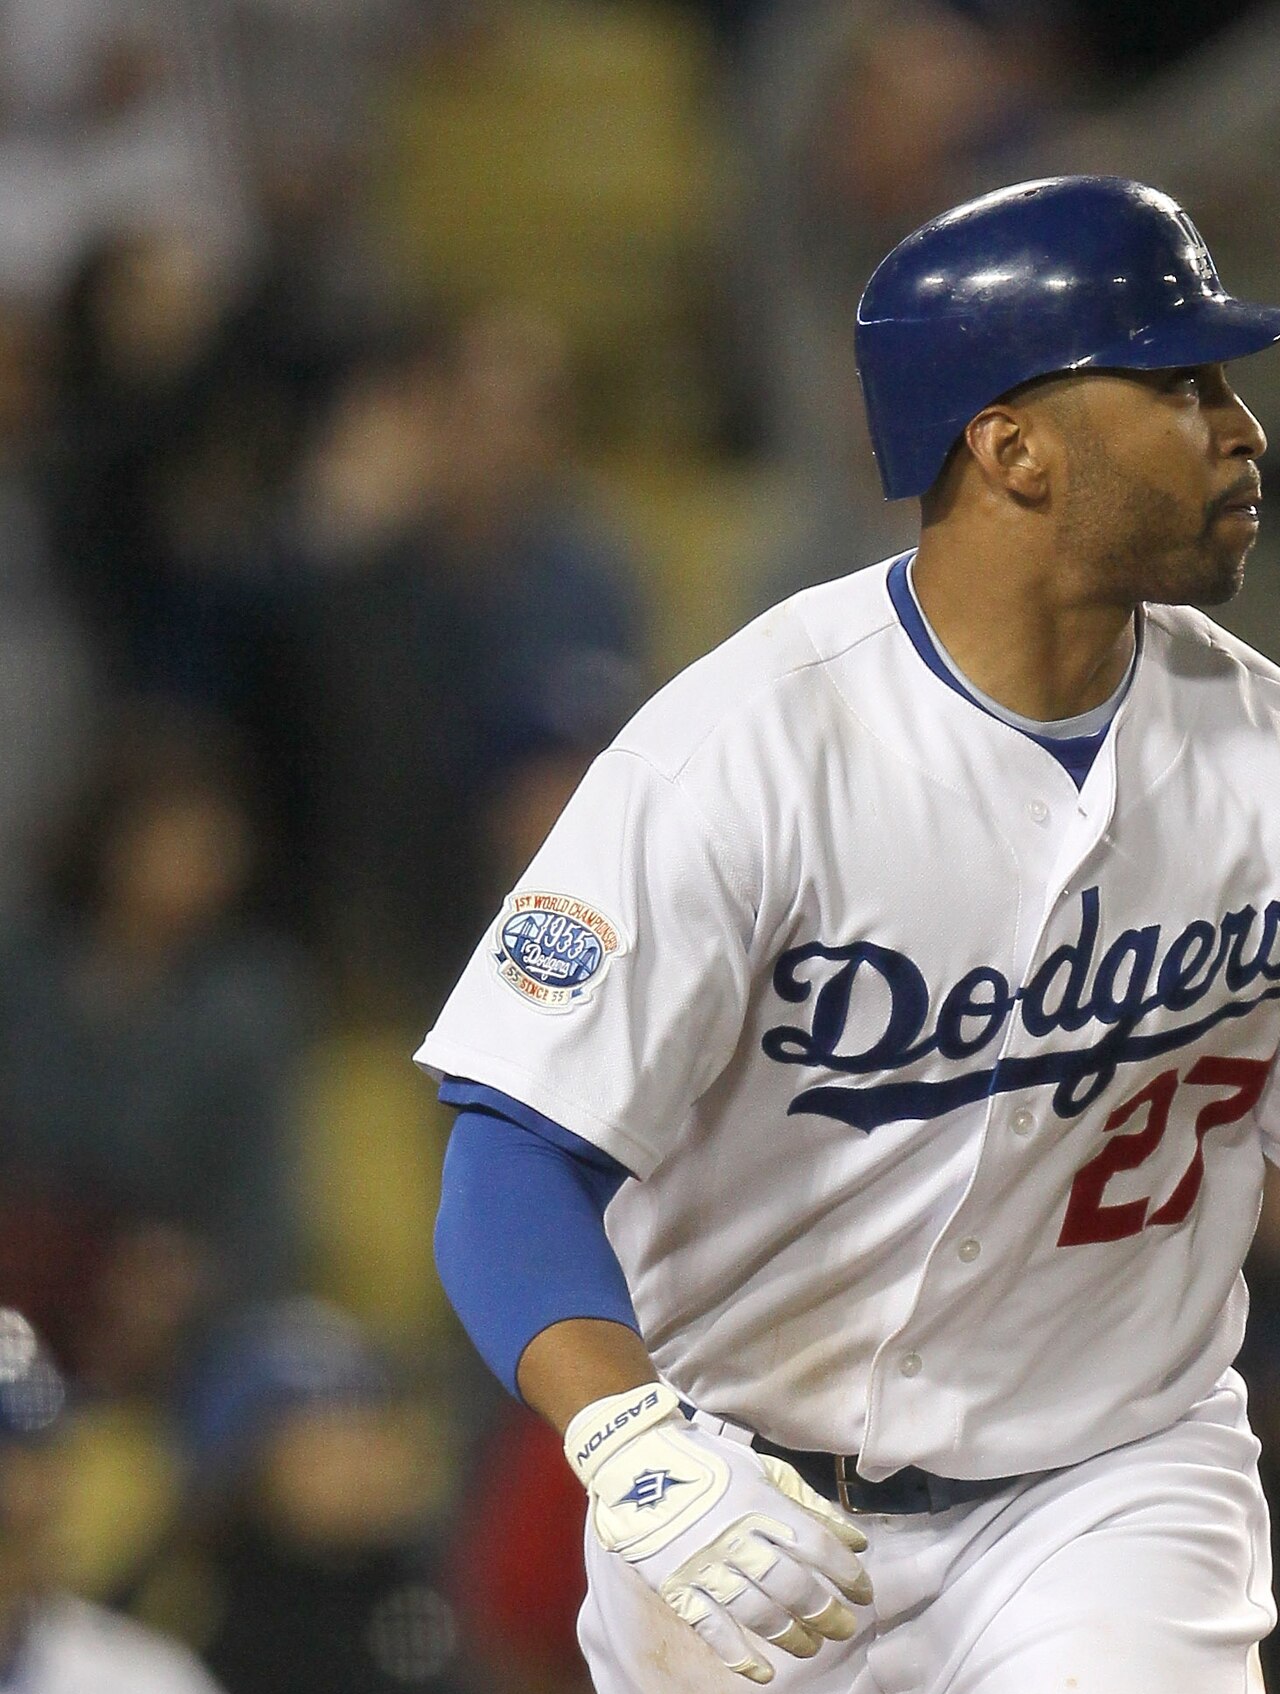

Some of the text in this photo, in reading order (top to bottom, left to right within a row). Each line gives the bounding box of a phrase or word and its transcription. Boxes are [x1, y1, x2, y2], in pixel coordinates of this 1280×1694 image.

[515, 895, 532, 912] 1ST
[533, 895, 569, 914] WORLD
[534, 914, 593, 960] 1955
[521, 939, 571, 981] Dodgers
[506, 966, 565, 1001] 55 SINCE 55
[1056, 1054, 1277, 1248] 27
[576, 1391, 659, 1467] EASTON
